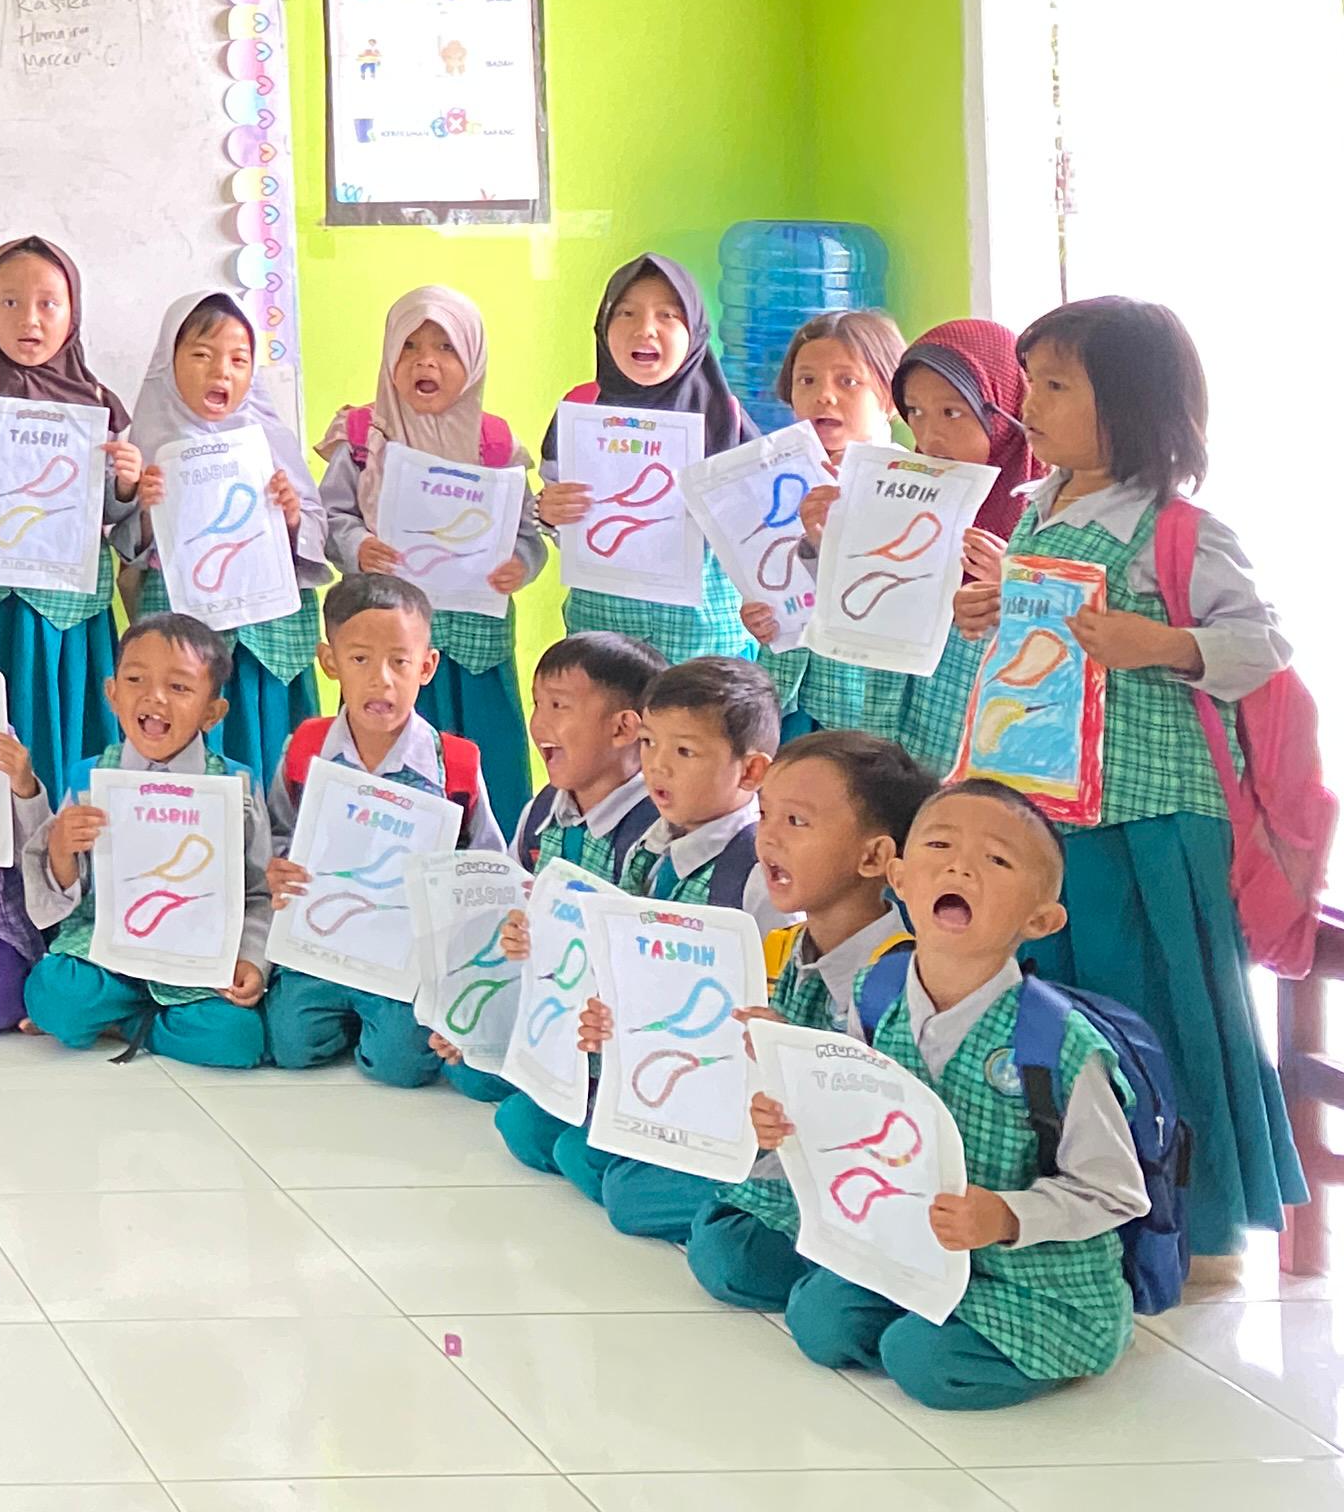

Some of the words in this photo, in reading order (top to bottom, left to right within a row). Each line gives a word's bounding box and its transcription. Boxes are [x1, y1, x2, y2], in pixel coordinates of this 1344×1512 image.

[9, 429, 69, 446] TASBIH
[180, 461, 239, 484] TASBIH
[876, 479, 939, 502] TASBIH
[453, 887, 516, 906] TASBIH
[636, 935, 715, 966] TASBIH
